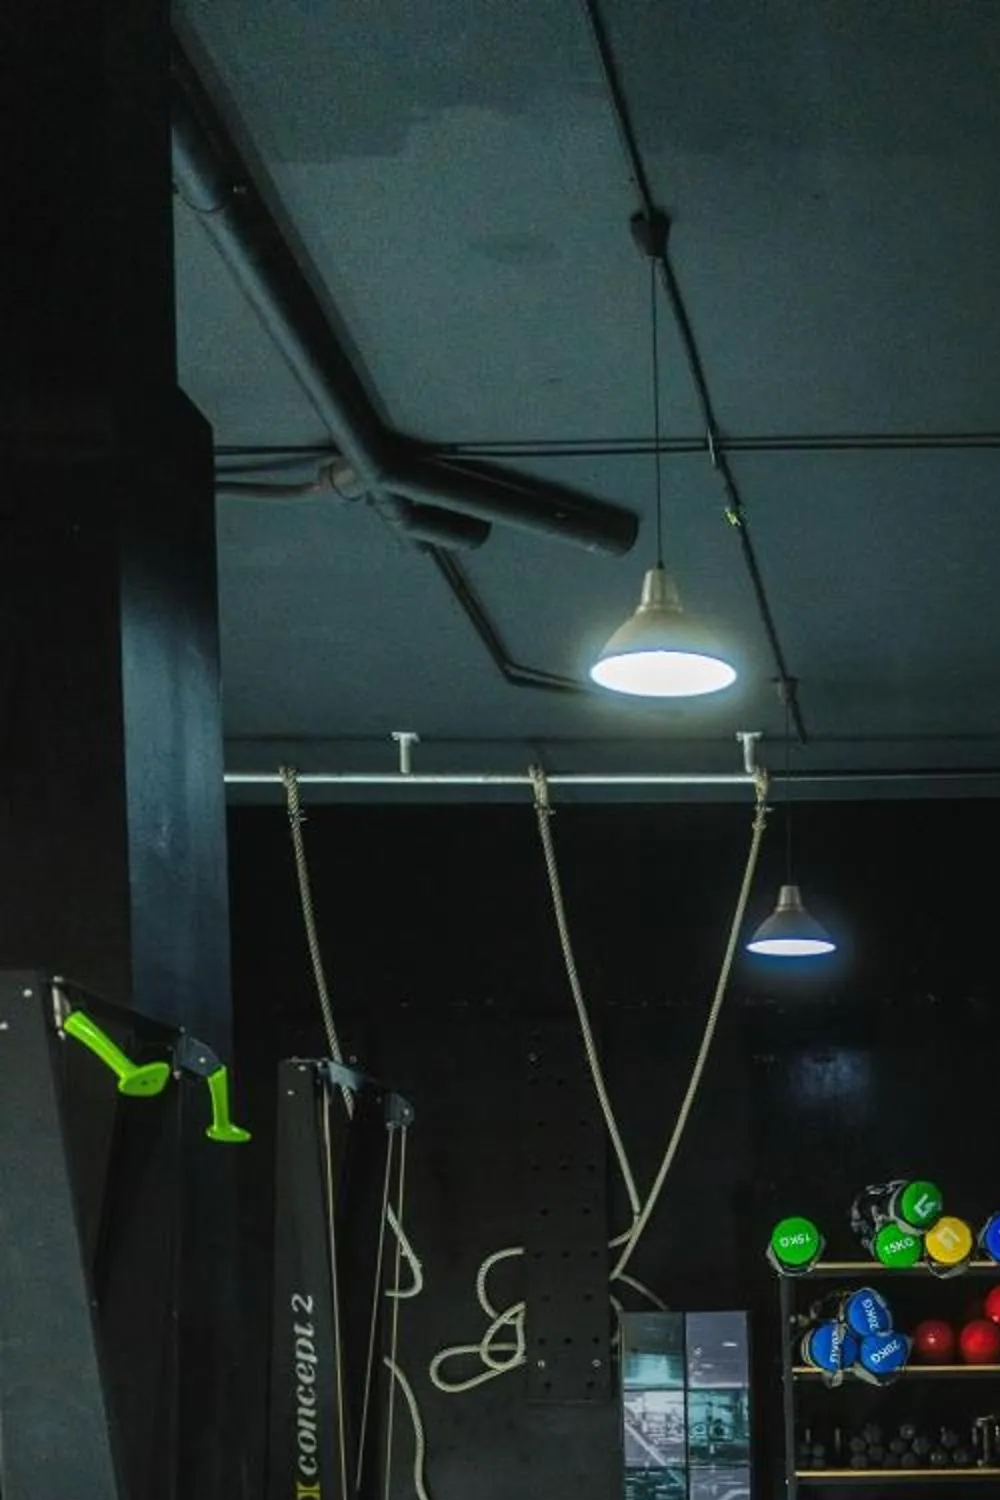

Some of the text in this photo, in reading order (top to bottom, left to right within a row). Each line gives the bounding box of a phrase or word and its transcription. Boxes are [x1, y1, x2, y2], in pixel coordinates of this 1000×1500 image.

[780, 1234, 811, 1248] 15KG
[291, 1293, 319, 1477] concept 2
